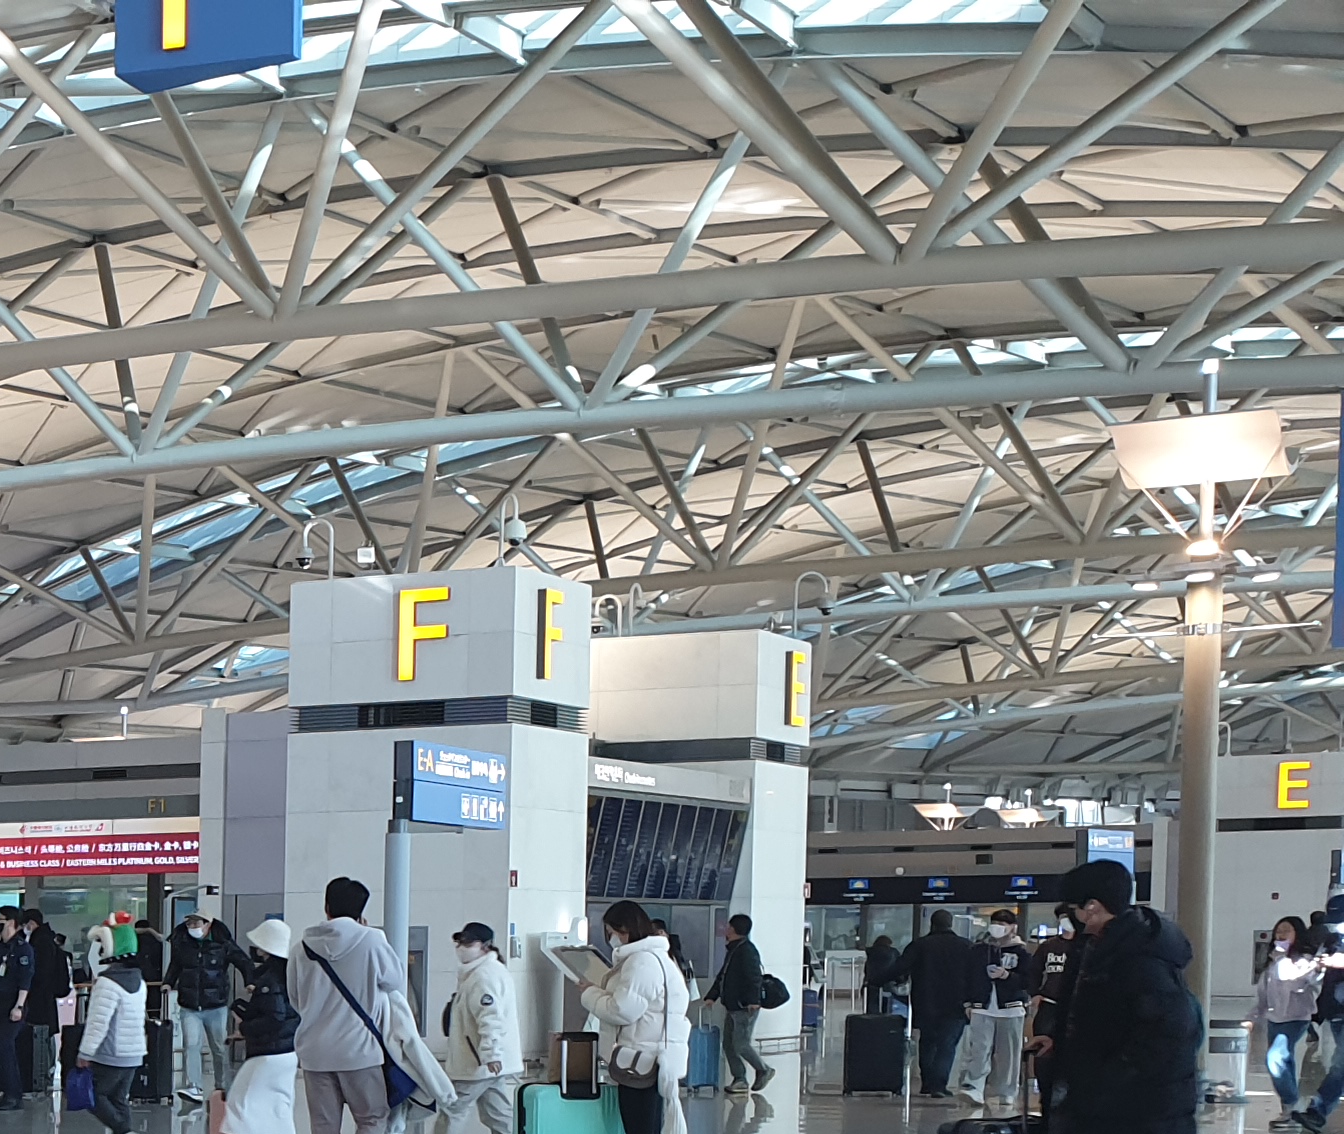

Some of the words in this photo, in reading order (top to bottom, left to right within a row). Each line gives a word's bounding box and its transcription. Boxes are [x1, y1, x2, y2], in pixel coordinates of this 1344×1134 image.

[396, 585, 452, 683] F
[537, 587, 565, 681] F
[784, 650, 807, 728] E
[417, 748, 434, 772] E-A
[1276, 760, 1312, 810] E
[147, 798, 166, 814] F1
[6, 860, 38, 868] BUSINESS
[40, 860, 60, 868] CLASS
[154, 857, 175, 865] GOLD,
